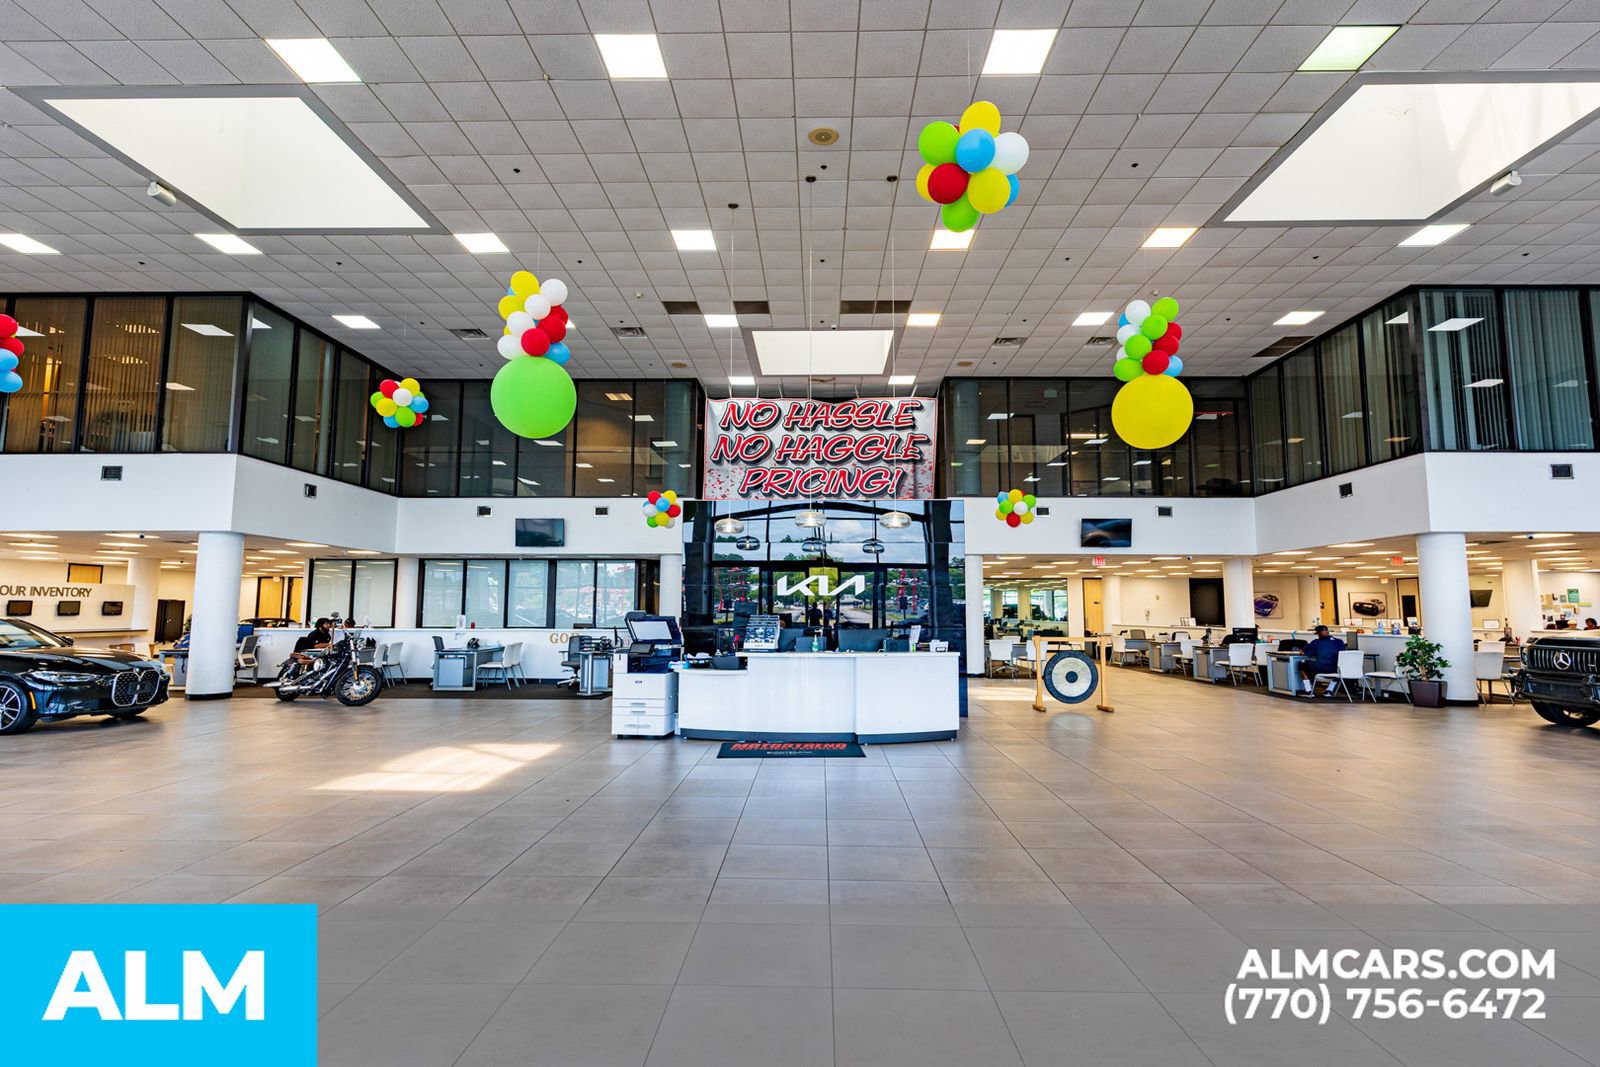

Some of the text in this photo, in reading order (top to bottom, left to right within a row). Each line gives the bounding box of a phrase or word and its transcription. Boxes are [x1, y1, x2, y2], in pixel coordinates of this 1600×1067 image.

[719, 401, 922, 429] NO HASSLE
[710, 434, 929, 462] NO HAGGLE
[736, 466, 904, 496] PRICING!
[0, 585, 92, 597] OUR INVENTORY
[776, 575, 865, 596] KIA
